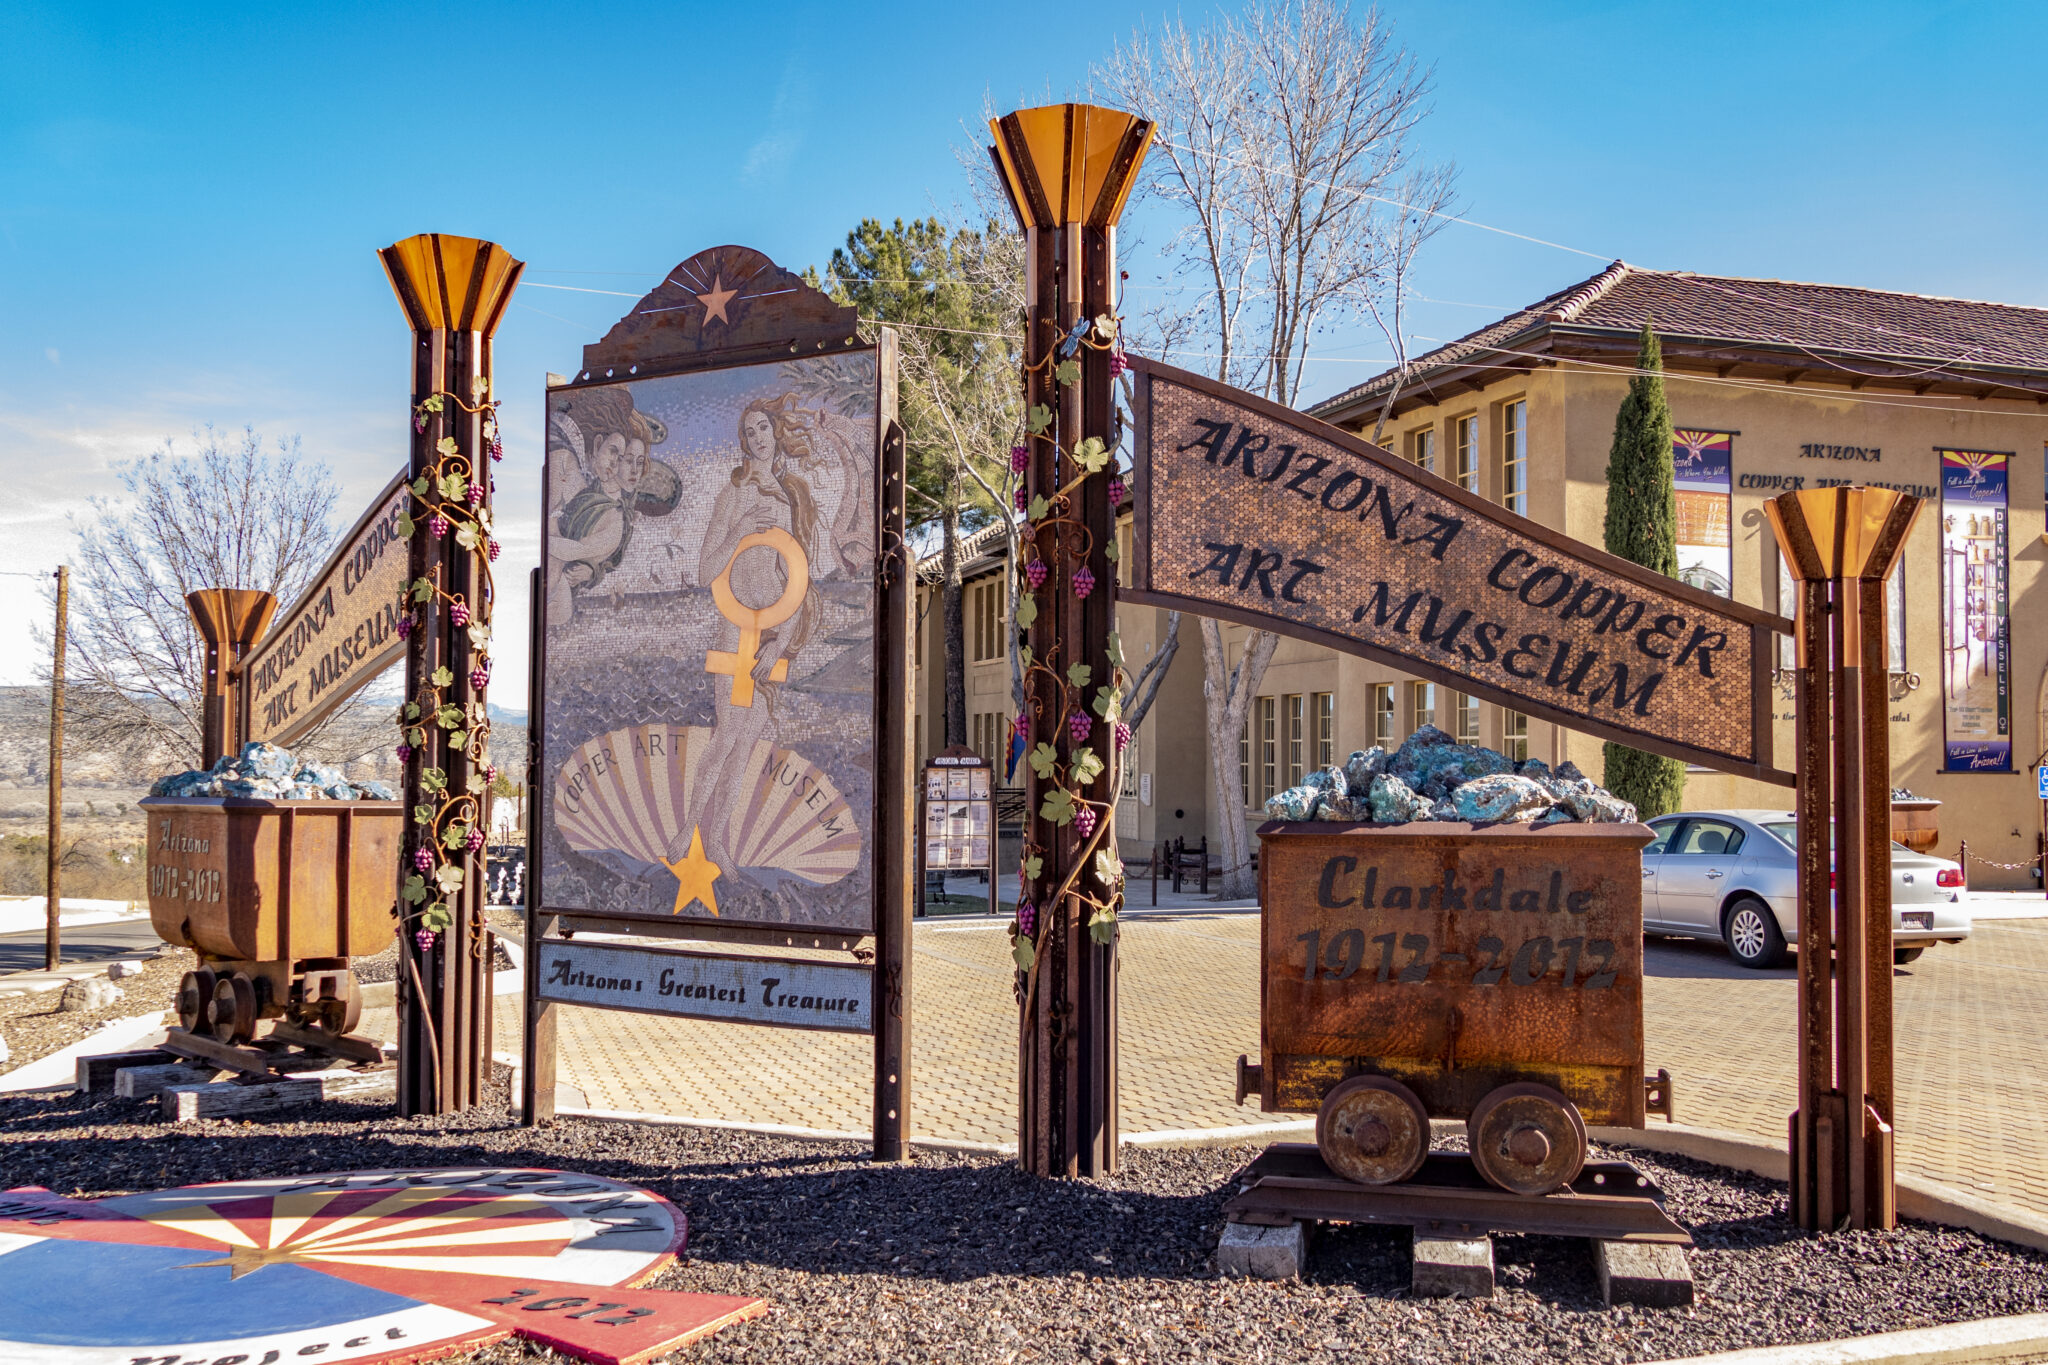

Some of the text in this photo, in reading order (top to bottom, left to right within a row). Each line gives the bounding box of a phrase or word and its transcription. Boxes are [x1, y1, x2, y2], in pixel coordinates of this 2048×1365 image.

[1738, 473, 1805, 491] COPPER
[1799, 443, 1882, 463] ARIZONA
[1177, 417, 1728, 678] ARIZONA COPPER
[254, 494, 410, 702] ARIZONA COPPE
[1996, 511, 2006, 696] DRINKING VESSELS
[1189, 542, 1665, 717] ART MUSEUM
[264, 679, 298, 735] ART
[562, 734, 844, 840] COPPER ART MUSEUM
[158, 818, 210, 854] Arizona
[150, 864, 221, 903] 1912-2012
[1317, 855, 1595, 915] Clarkdale
[548, 959, 860, 1012] Arizonas Greatest Treasure
[1298, 927, 1620, 991] 1912-2012
[481, 1287, 657, 1326] 2012
